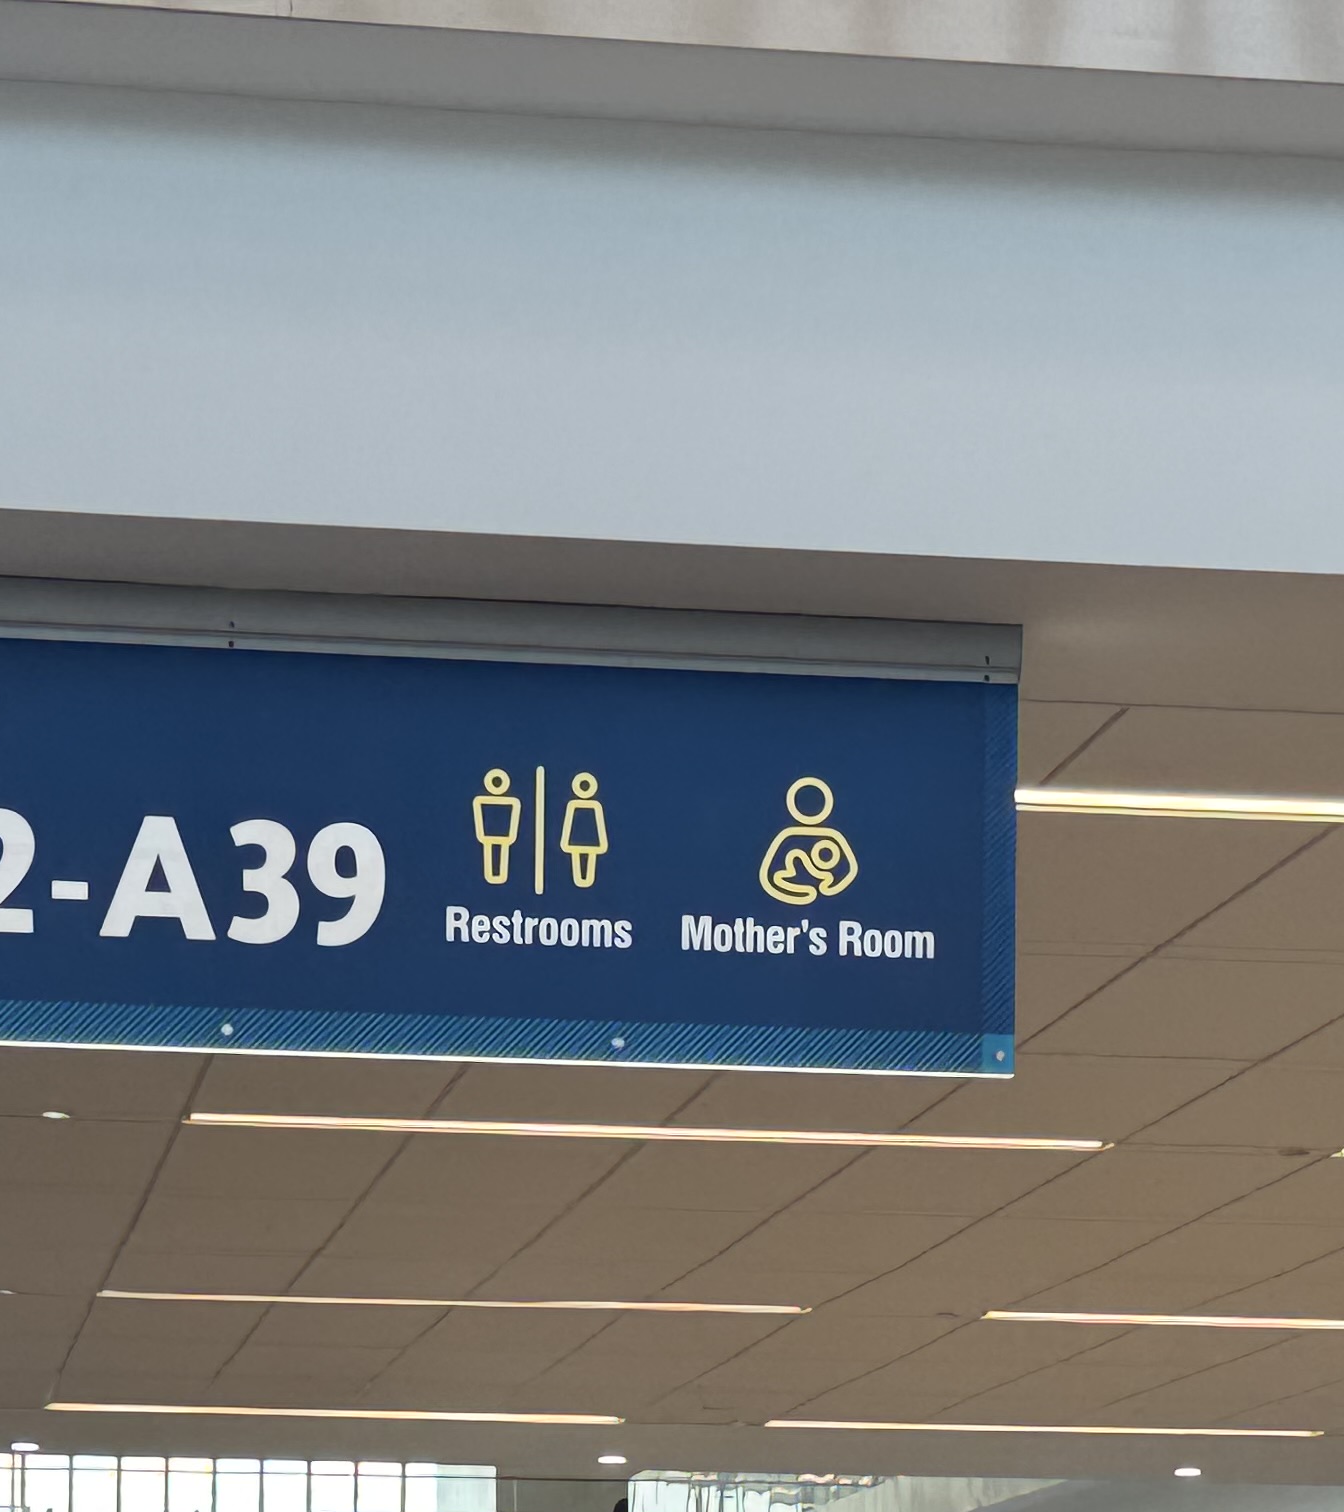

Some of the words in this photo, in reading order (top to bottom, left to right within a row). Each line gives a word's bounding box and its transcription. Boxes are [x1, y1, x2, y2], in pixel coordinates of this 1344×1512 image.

[445, 905, 633, 949] Restrooms
[681, 914, 828, 956] Mother's
[838, 920, 935, 959] Room
